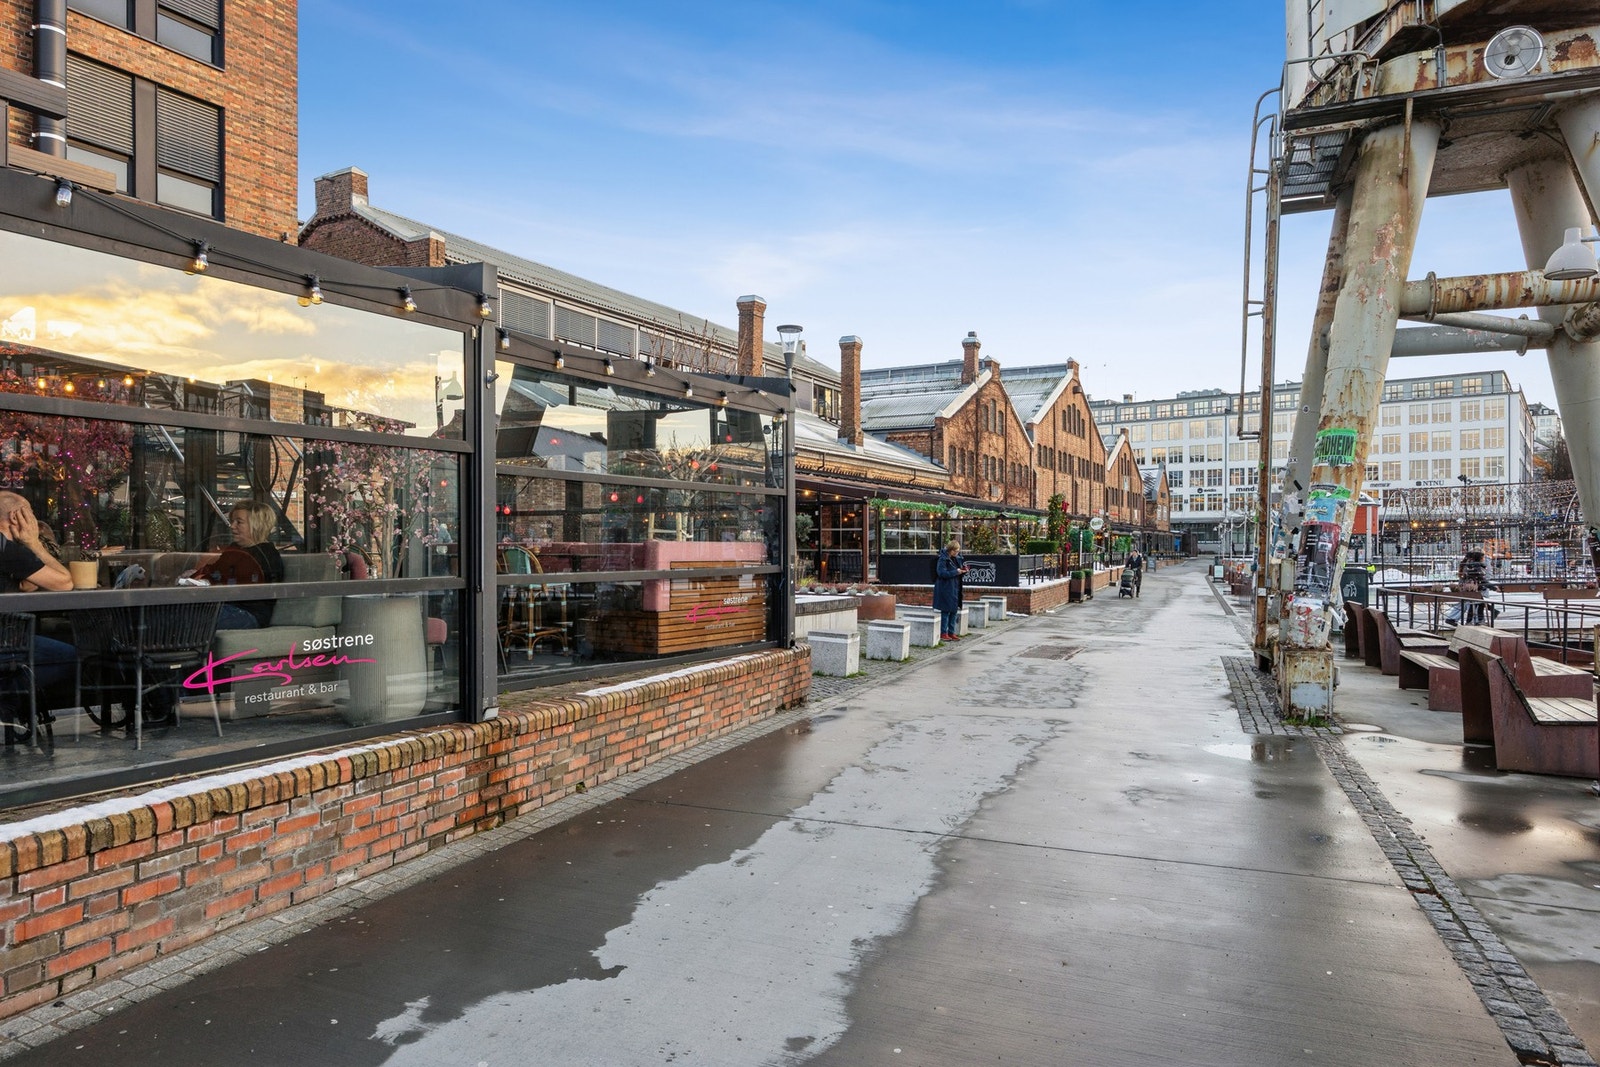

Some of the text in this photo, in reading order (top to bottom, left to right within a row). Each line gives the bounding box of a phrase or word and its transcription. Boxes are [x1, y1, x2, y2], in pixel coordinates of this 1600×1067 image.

[303, 633, 374, 652] søstrene
[183, 641, 377, 694] Karlsen
[244, 682, 338, 704] restaurant & bar
